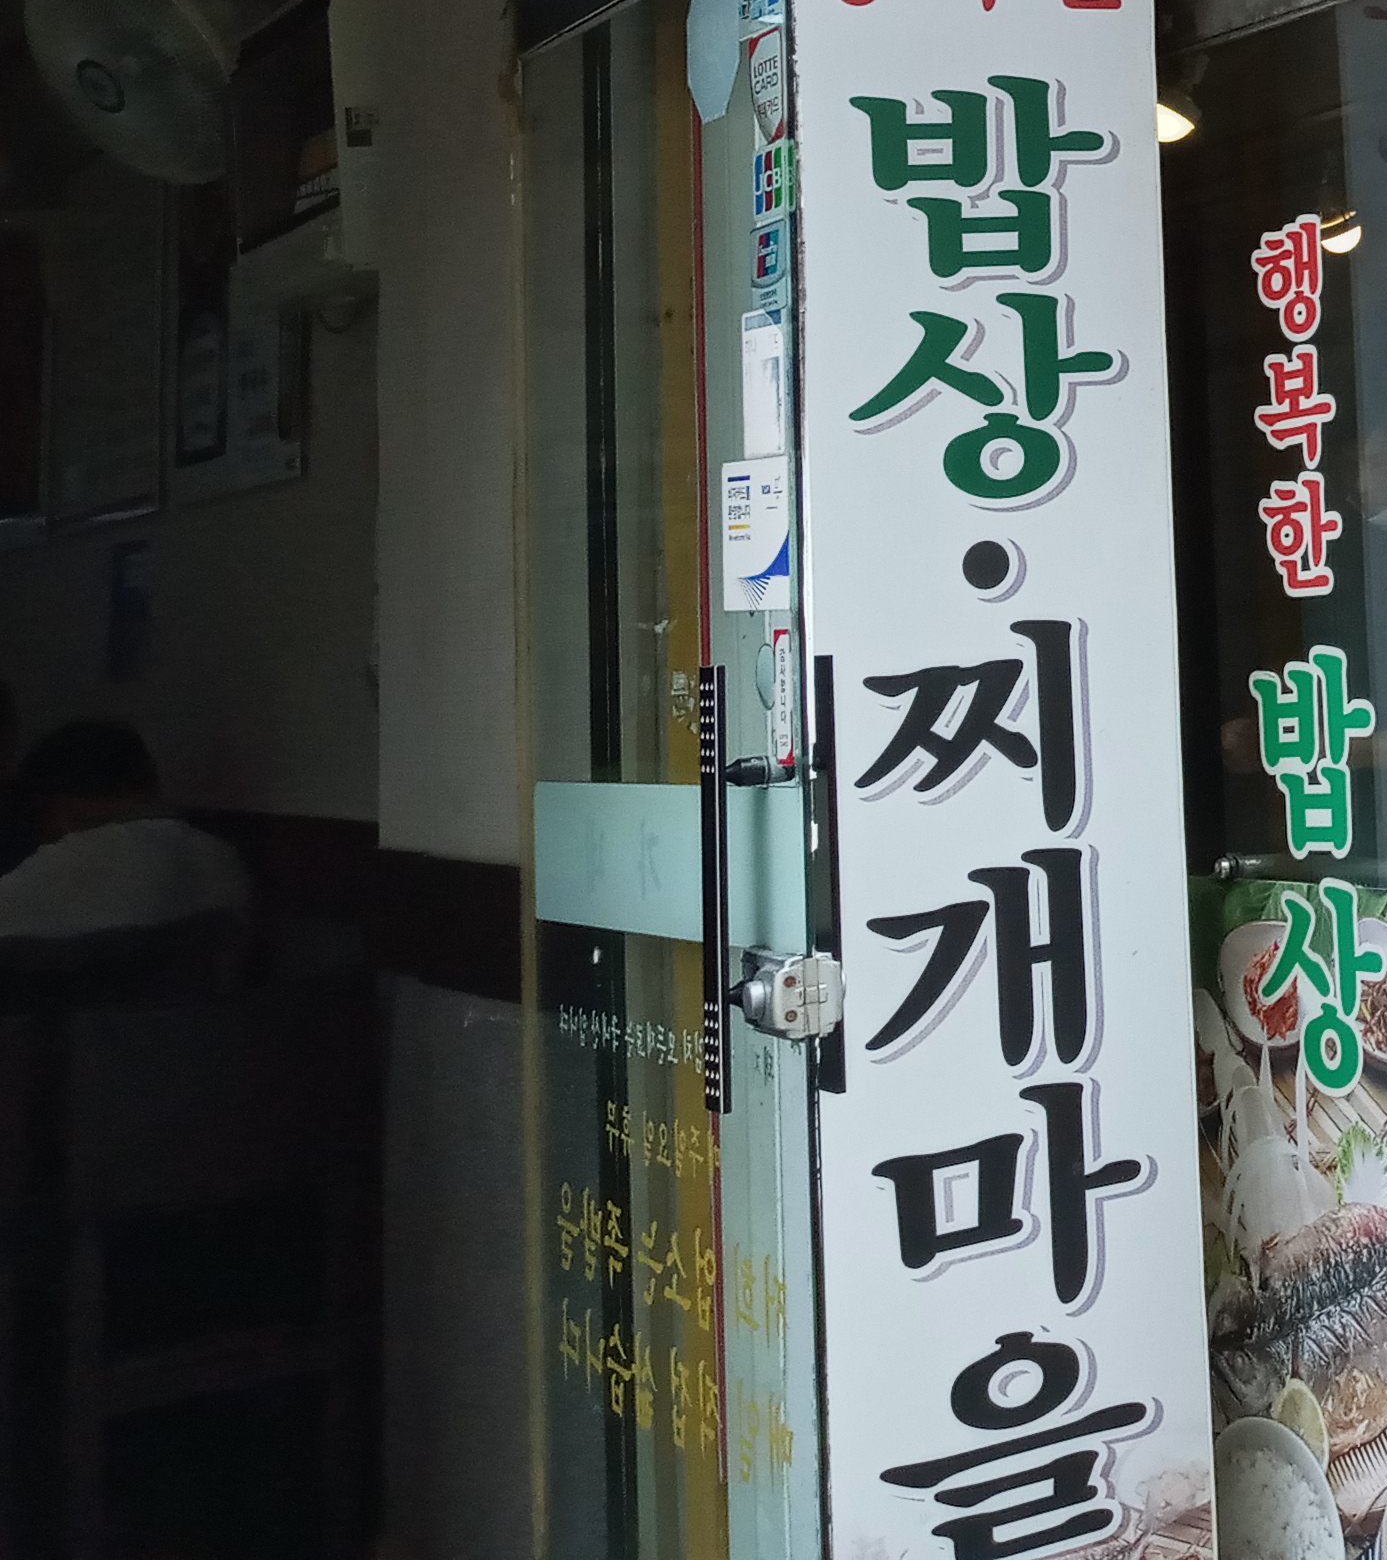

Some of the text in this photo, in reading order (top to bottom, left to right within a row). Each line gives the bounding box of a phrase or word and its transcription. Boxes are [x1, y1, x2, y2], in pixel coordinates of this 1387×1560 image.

[753, 54, 779, 79] LOTTE
[754, 72, 780, 95] CARD
[754, 167, 783, 197] JCB
[1252, 215, 1342, 597] 행복한
[1250, 645, 1384, 1098] 밥상
